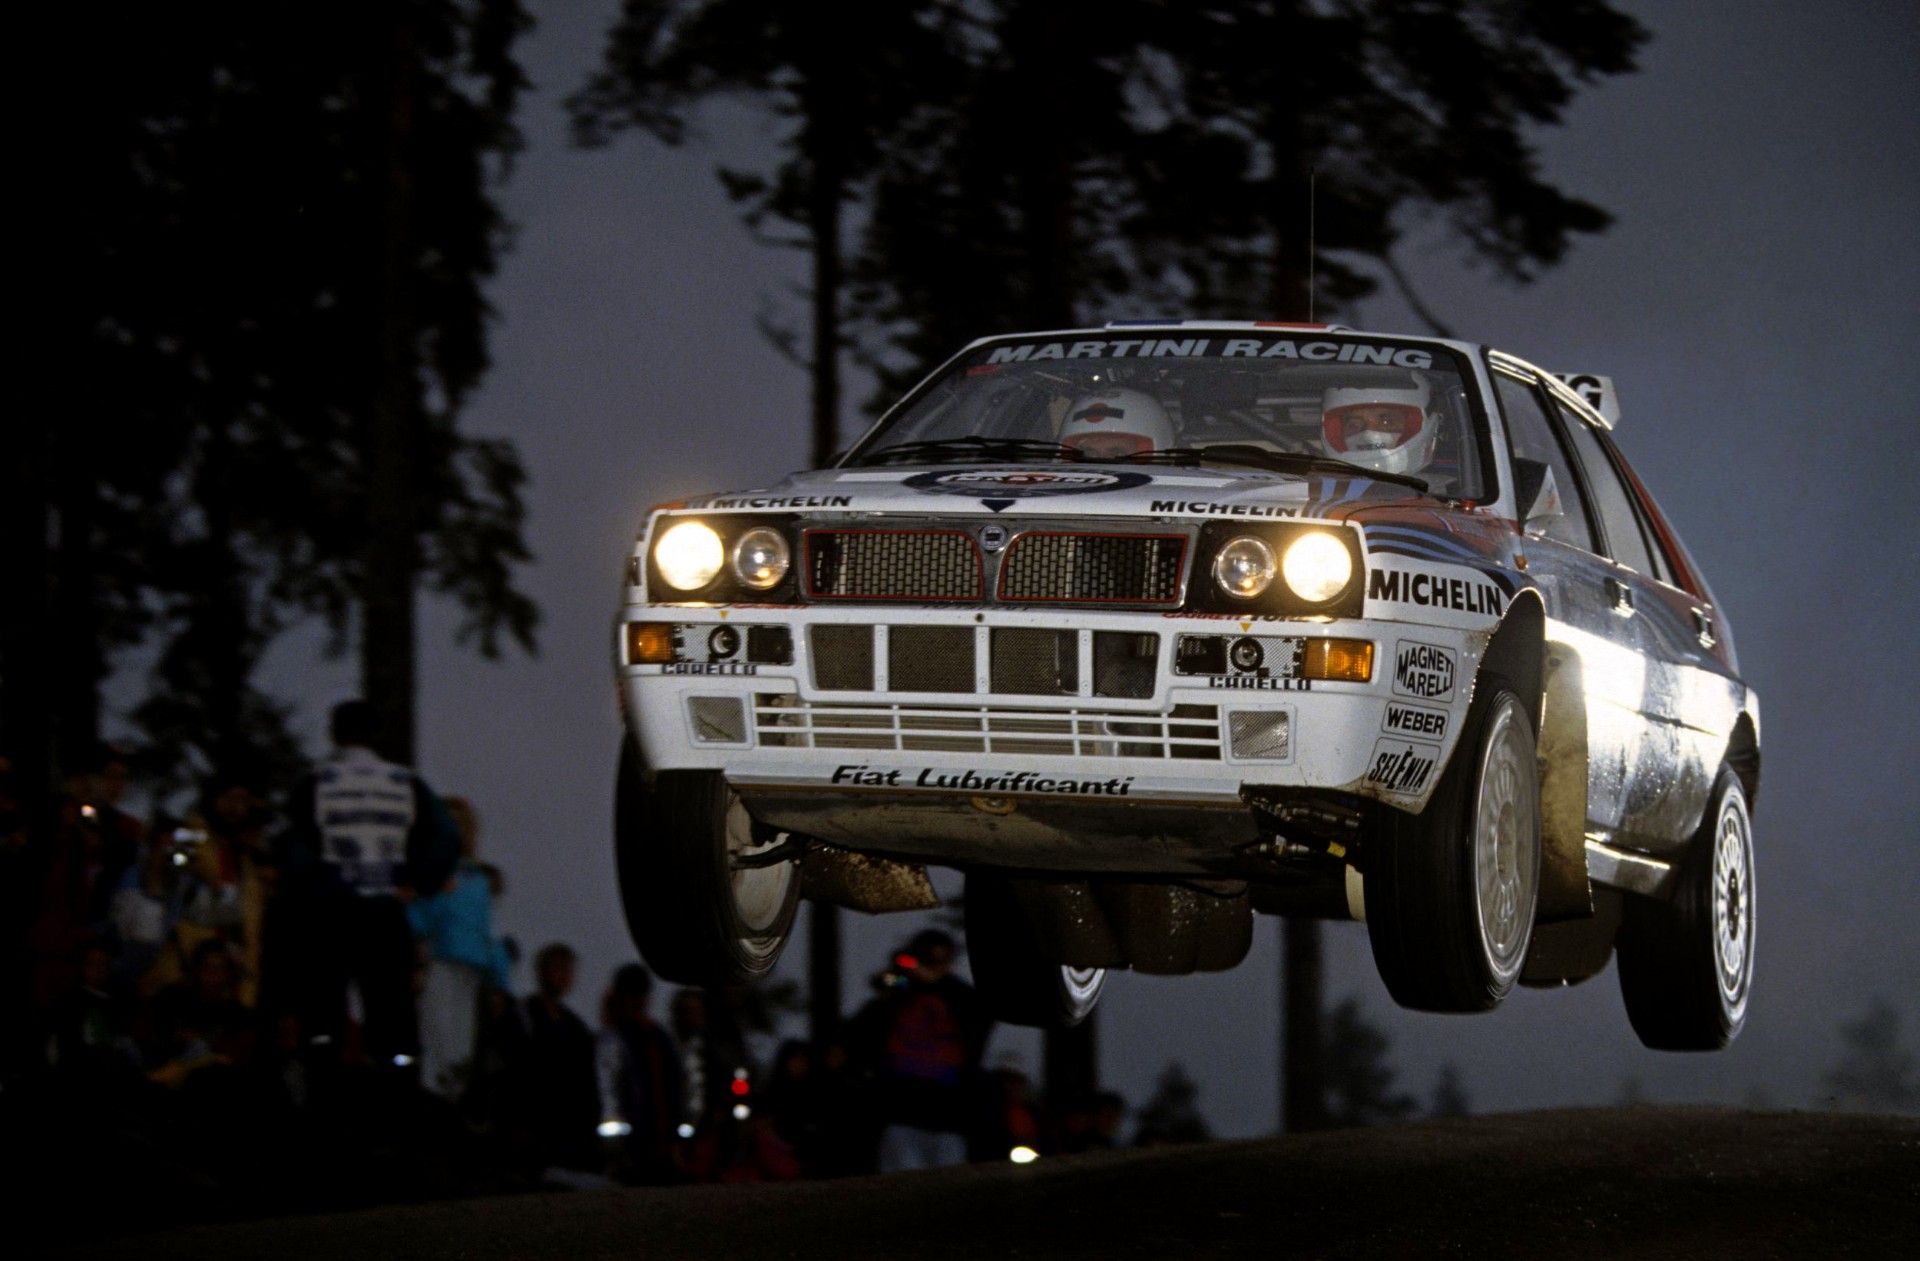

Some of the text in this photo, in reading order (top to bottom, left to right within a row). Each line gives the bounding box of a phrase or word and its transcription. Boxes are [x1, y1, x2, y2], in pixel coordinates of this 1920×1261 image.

[986, 339, 1433, 369] MARTINI RACING
[713, 496, 853, 509] MICHELIN
[1150, 500, 1298, 518] MICHELIN
[1368, 568, 1503, 617] MICHELIN
[1387, 706, 1446, 735] WEBER
[831, 765, 1136, 797] Fiat Lubrificanti
